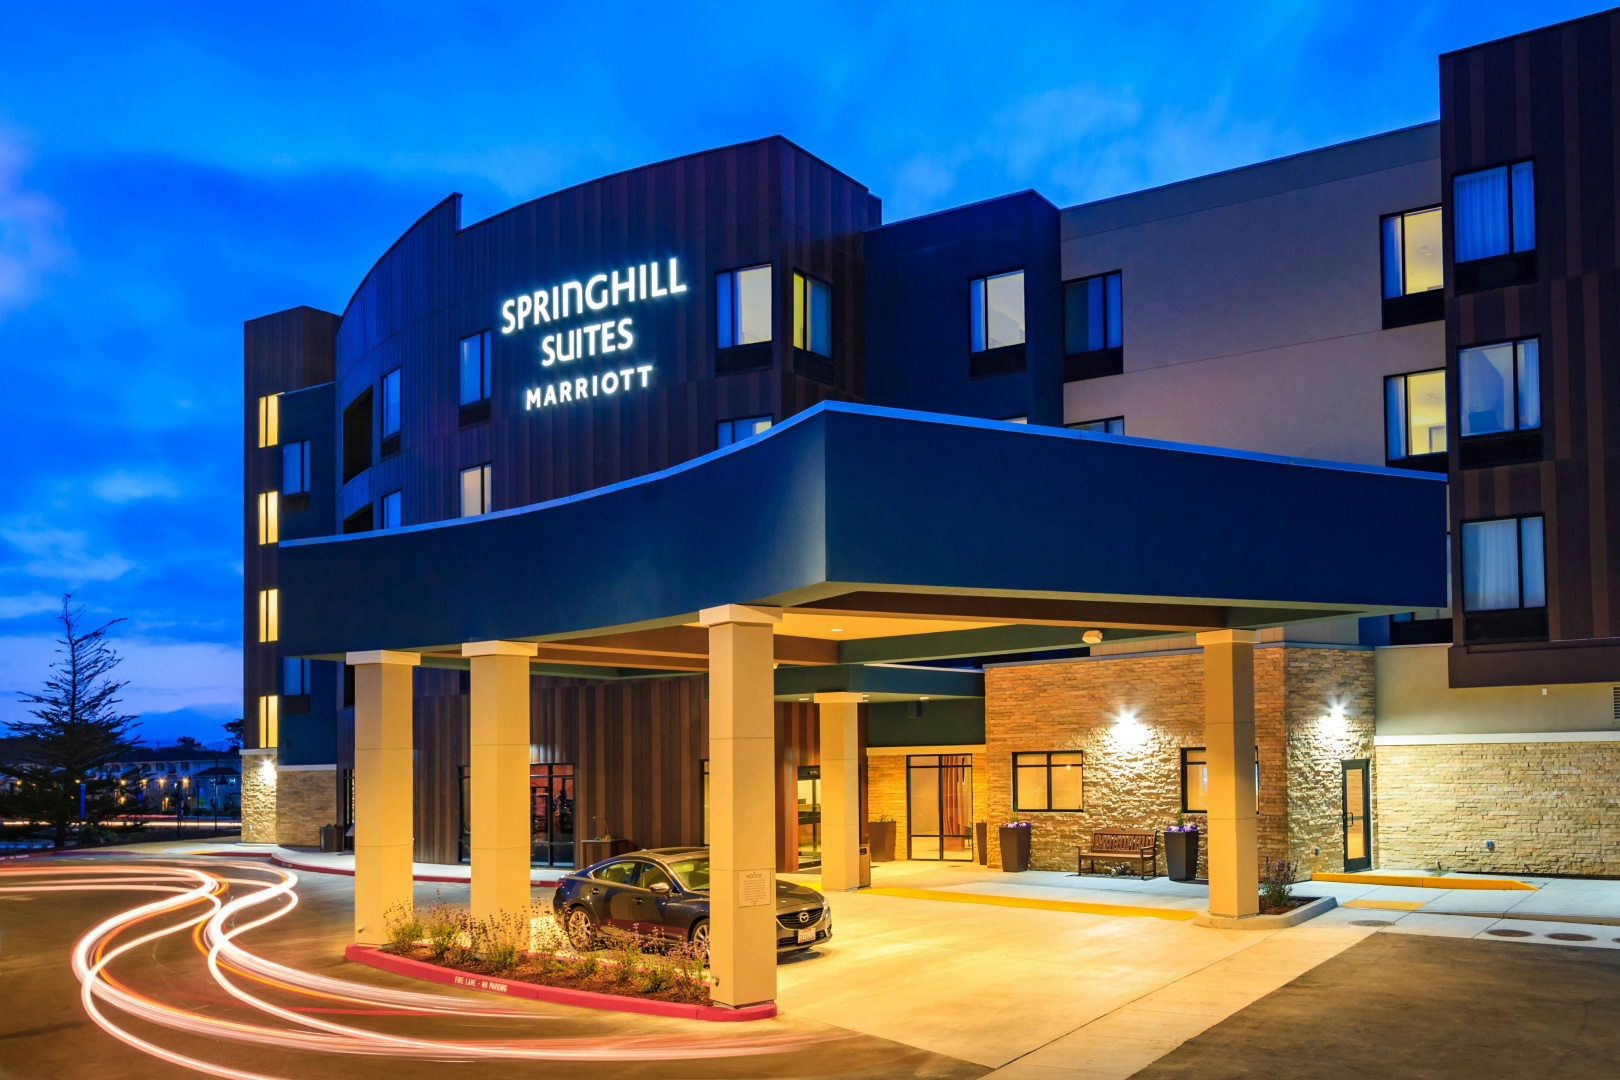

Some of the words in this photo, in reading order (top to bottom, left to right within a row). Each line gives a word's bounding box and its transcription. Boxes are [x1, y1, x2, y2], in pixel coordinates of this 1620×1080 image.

[502, 258, 687, 333] SPRINGHILL
[541, 318, 633, 366] SUITES
[526, 365, 652, 410] MARRIOTT
[454, 976, 464, 984] FIRE
[465, 978, 476, 986] LANE
[489, 982, 507, 992] PARKING
